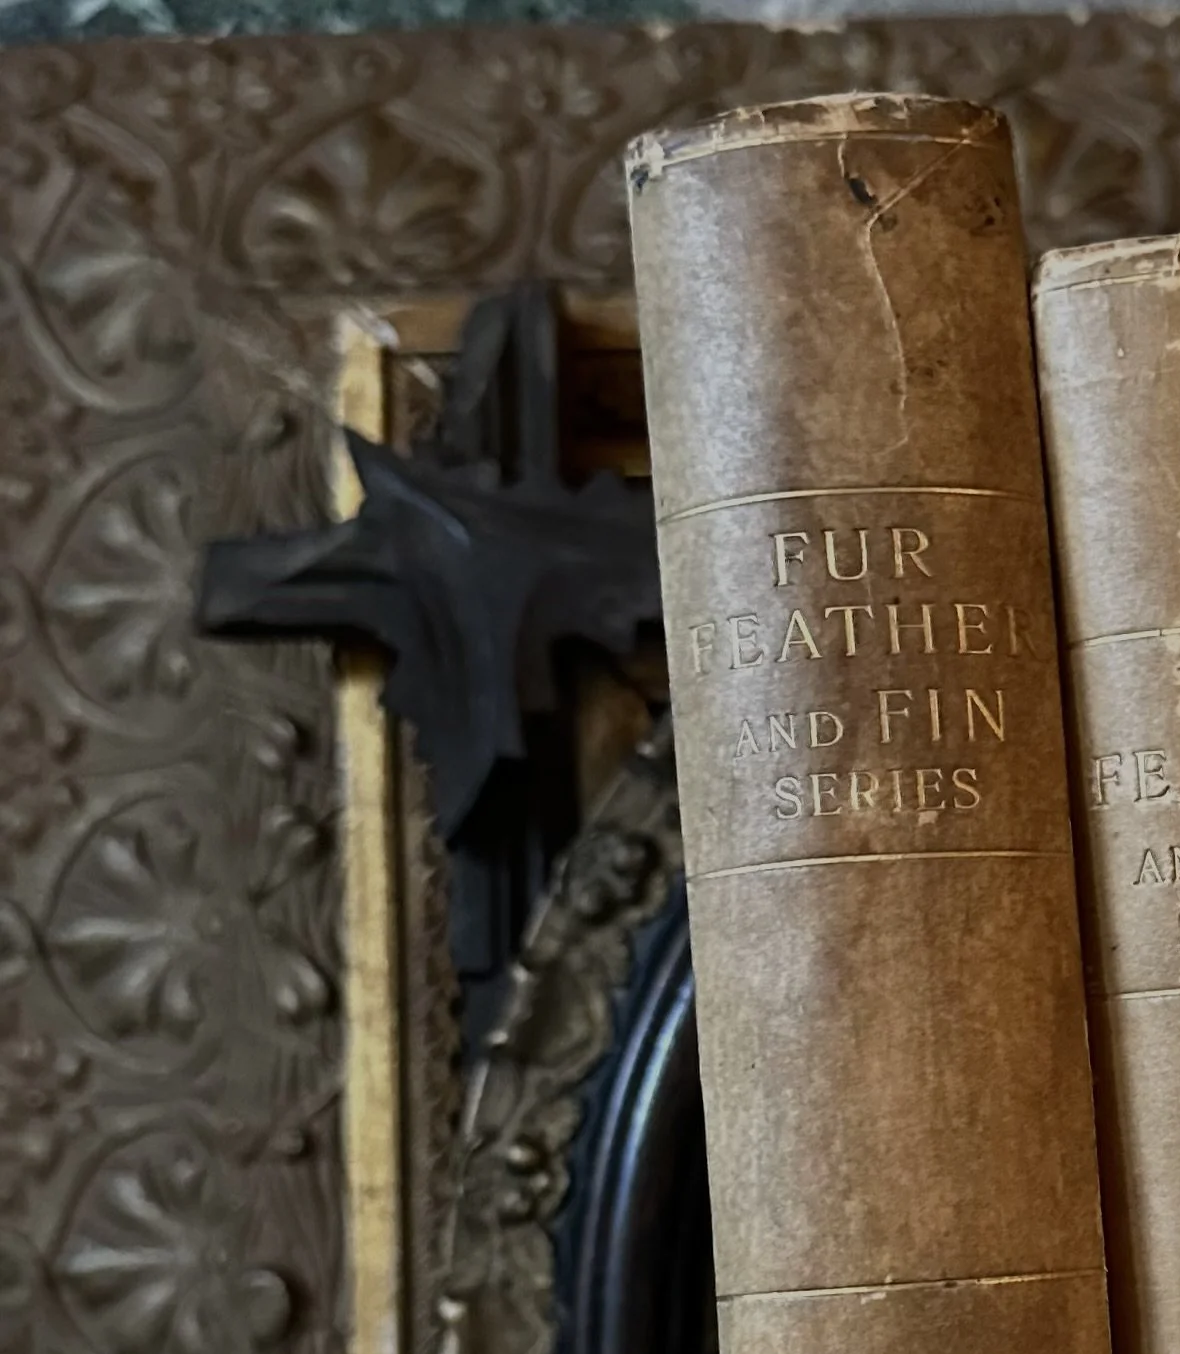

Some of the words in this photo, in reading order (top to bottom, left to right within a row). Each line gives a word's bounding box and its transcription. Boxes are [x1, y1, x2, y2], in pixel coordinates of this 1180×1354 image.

[769, 526, 934, 587] FUR
[689, 602, 1051, 674] FEATHER
[733, 710, 844, 758] AND
[875, 688, 1005, 745] FIN
[773, 768, 980, 820] SERIES
